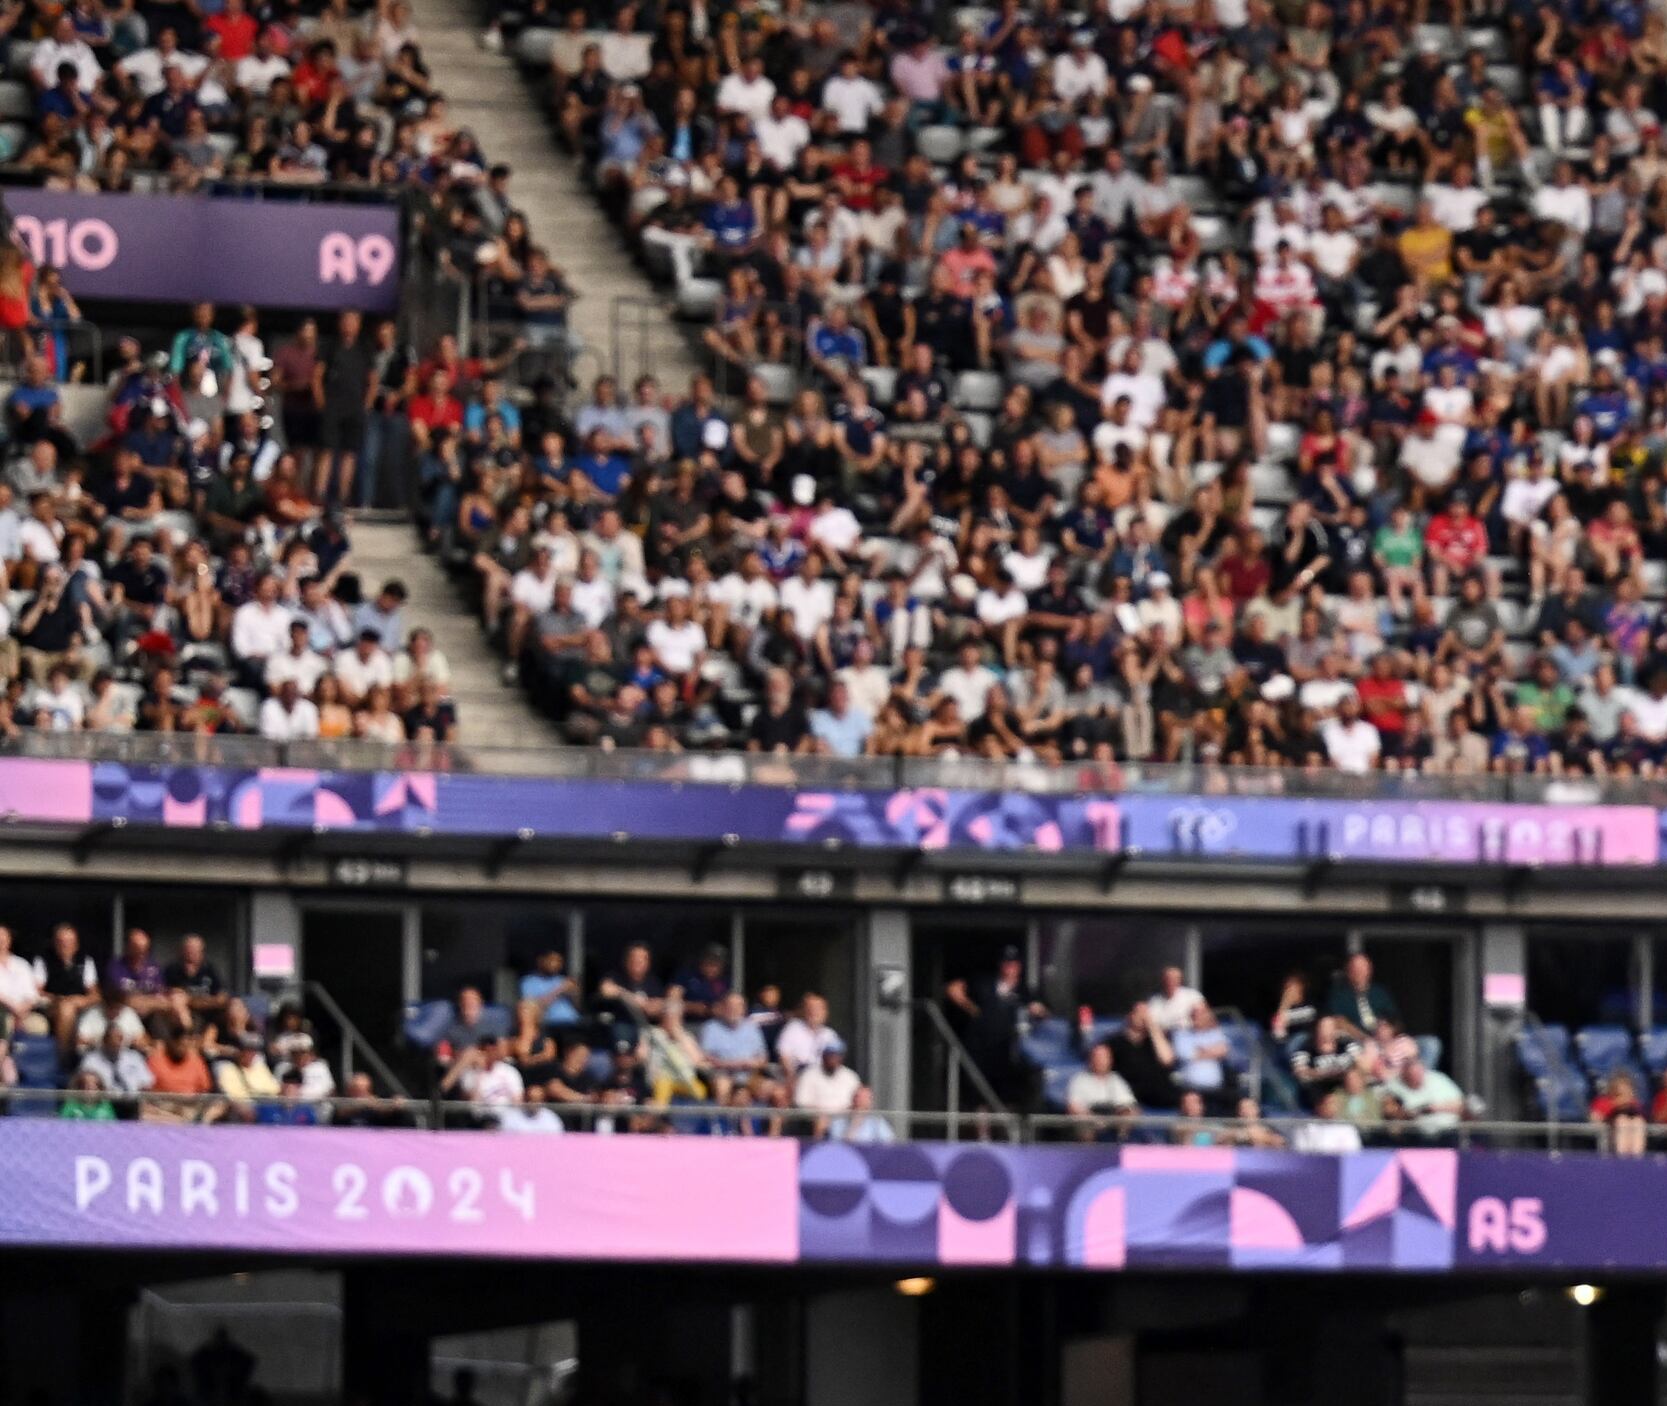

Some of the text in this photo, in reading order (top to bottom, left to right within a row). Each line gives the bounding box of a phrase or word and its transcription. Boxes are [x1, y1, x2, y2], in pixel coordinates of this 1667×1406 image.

[318, 231, 395, 285] A9
[75, 1155, 536, 1222] PARIS 2024
[1468, 1197, 1548, 1255] A5
